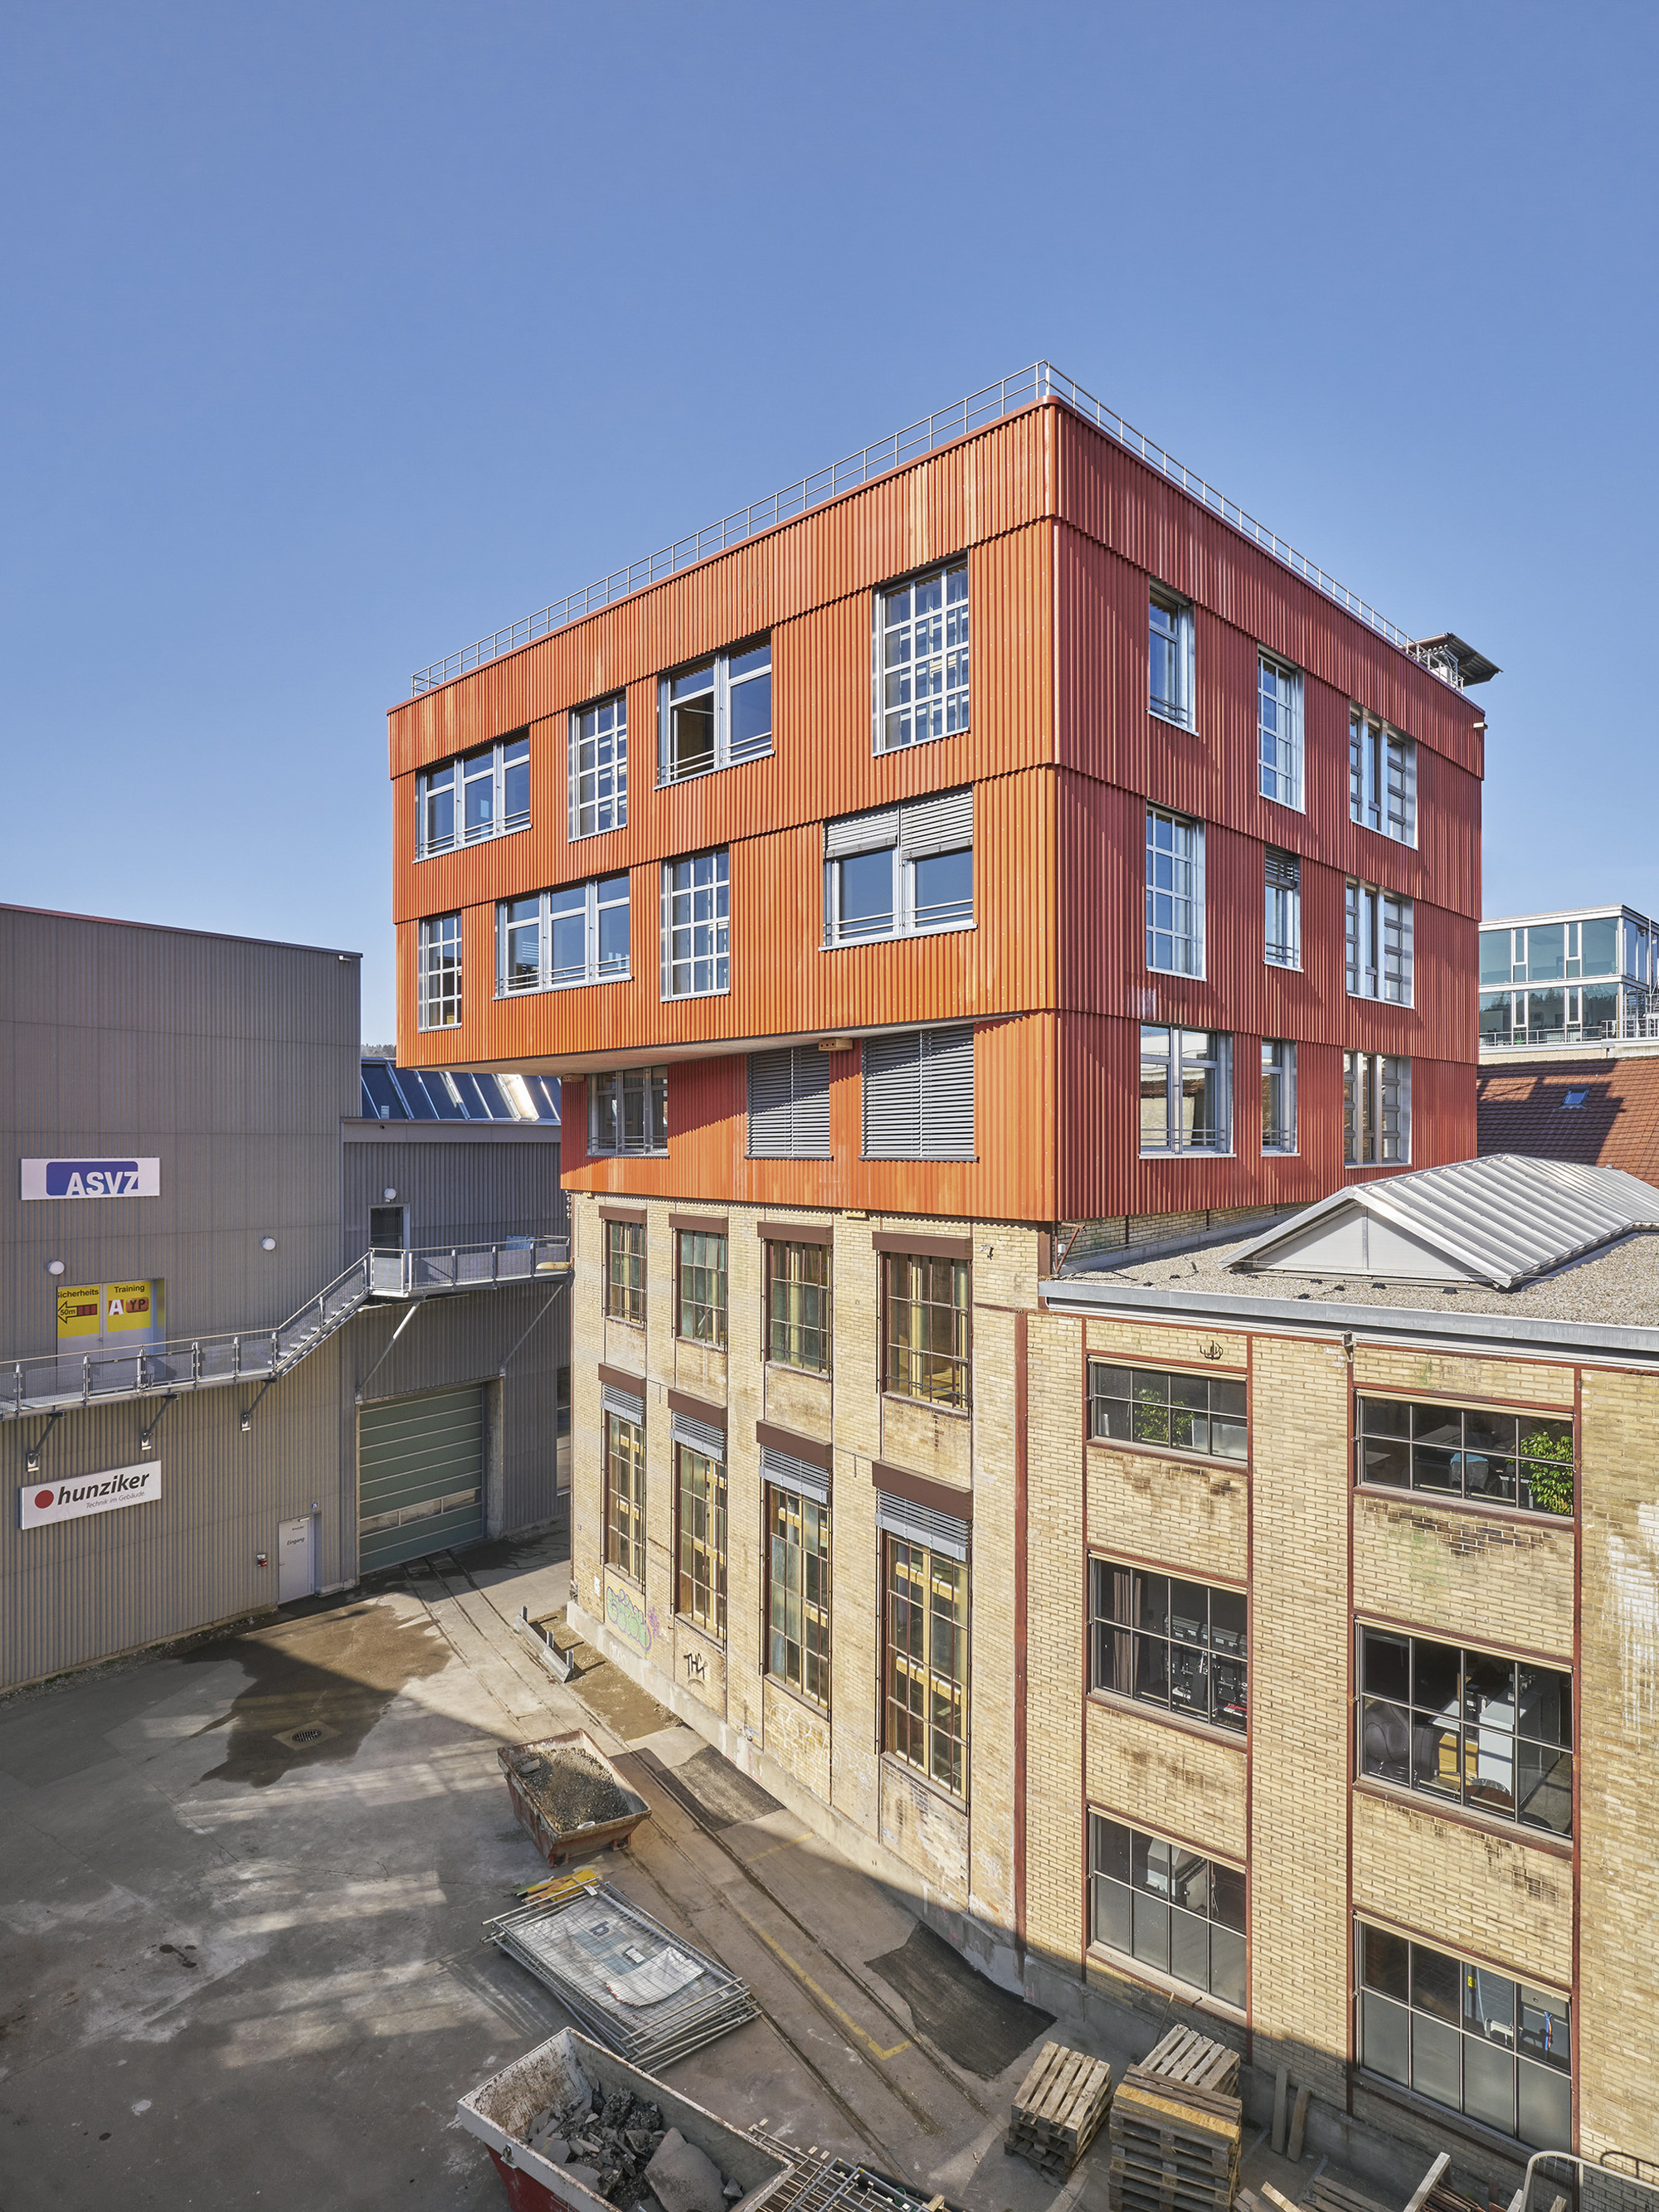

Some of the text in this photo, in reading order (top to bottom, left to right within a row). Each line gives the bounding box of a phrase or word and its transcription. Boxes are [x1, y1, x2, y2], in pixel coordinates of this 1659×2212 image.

[66, 1171, 139, 1195] ASVZ
[114, 1285, 145, 1294] Training
[109, 1299, 146, 1315] A YP
[57, 1473, 149, 1505] hunziker
[86, 1498, 108, 1509] Technik
[286, 1537, 305, 1545] Eingang
